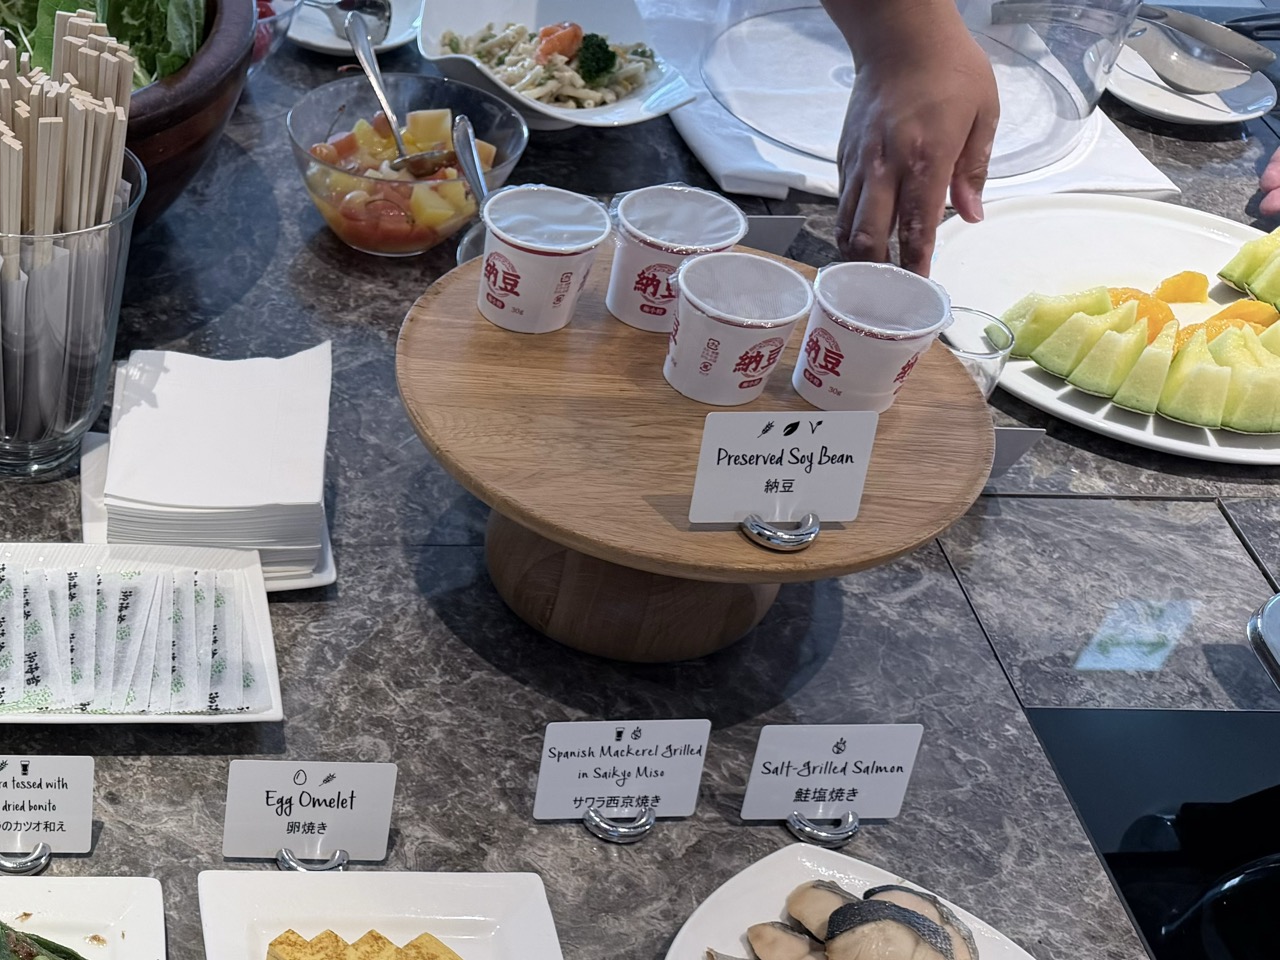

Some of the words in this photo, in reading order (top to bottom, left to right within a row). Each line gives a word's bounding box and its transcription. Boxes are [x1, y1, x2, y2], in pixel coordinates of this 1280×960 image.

[716, 447, 785, 466] Preserved
[787, 447, 813, 473] Soy
[817, 446, 854, 465] Bean
[764, 478, 795, 493] 納豆
[548, 746, 595, 762] Spanish
[599, 745, 658, 759] Mackerel
[851, 760, 904, 774] Salmon
[12, 776, 43, 789] tossed
[45, 777, 69, 790] with
[578, 769, 589, 779] in
[593, 766, 632, 787] Saikyo
[635, 766, 665, 779] Miso
[573, 795, 661, 809] サワラ西京焼き
[793, 787, 859, 802] 鮭塩焼き
[2, 799, 25, 812] dried
[28, 799, 57, 812] bonito
[265, 790, 294, 816] Egg
[299, 790, 356, 810] Omelet
[286, 821, 327, 835] 卵焼き
